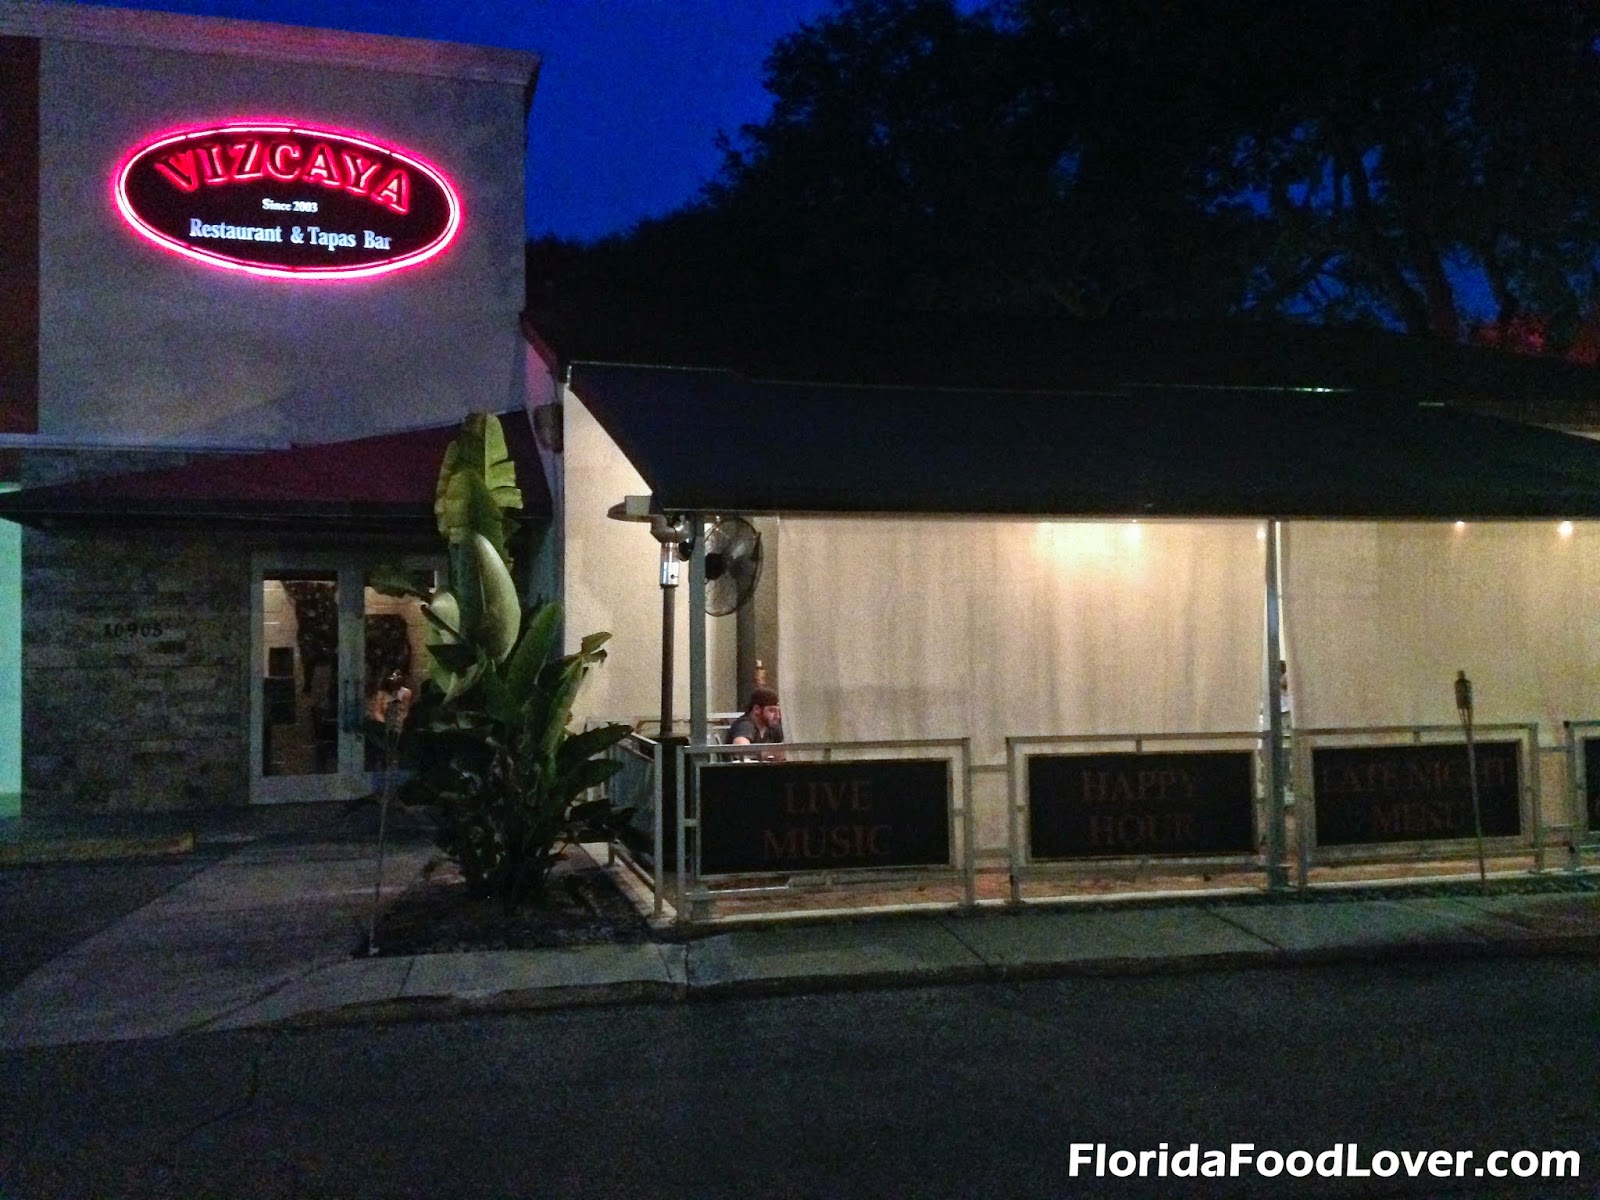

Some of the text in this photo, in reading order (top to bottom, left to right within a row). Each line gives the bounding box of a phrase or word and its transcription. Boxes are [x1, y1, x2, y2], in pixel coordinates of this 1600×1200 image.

[154, 139, 411, 214] VIZCAYA
[262, 198, 318, 213] Since 2003
[189, 218, 391, 251] Restaurant & Tapas Bar
[784, 779, 873, 814] LIVE
[1081, 769, 1196, 801] HAPPY
[762, 823, 892, 860] MUSIC
[1090, 813, 1195, 846] HOUR
